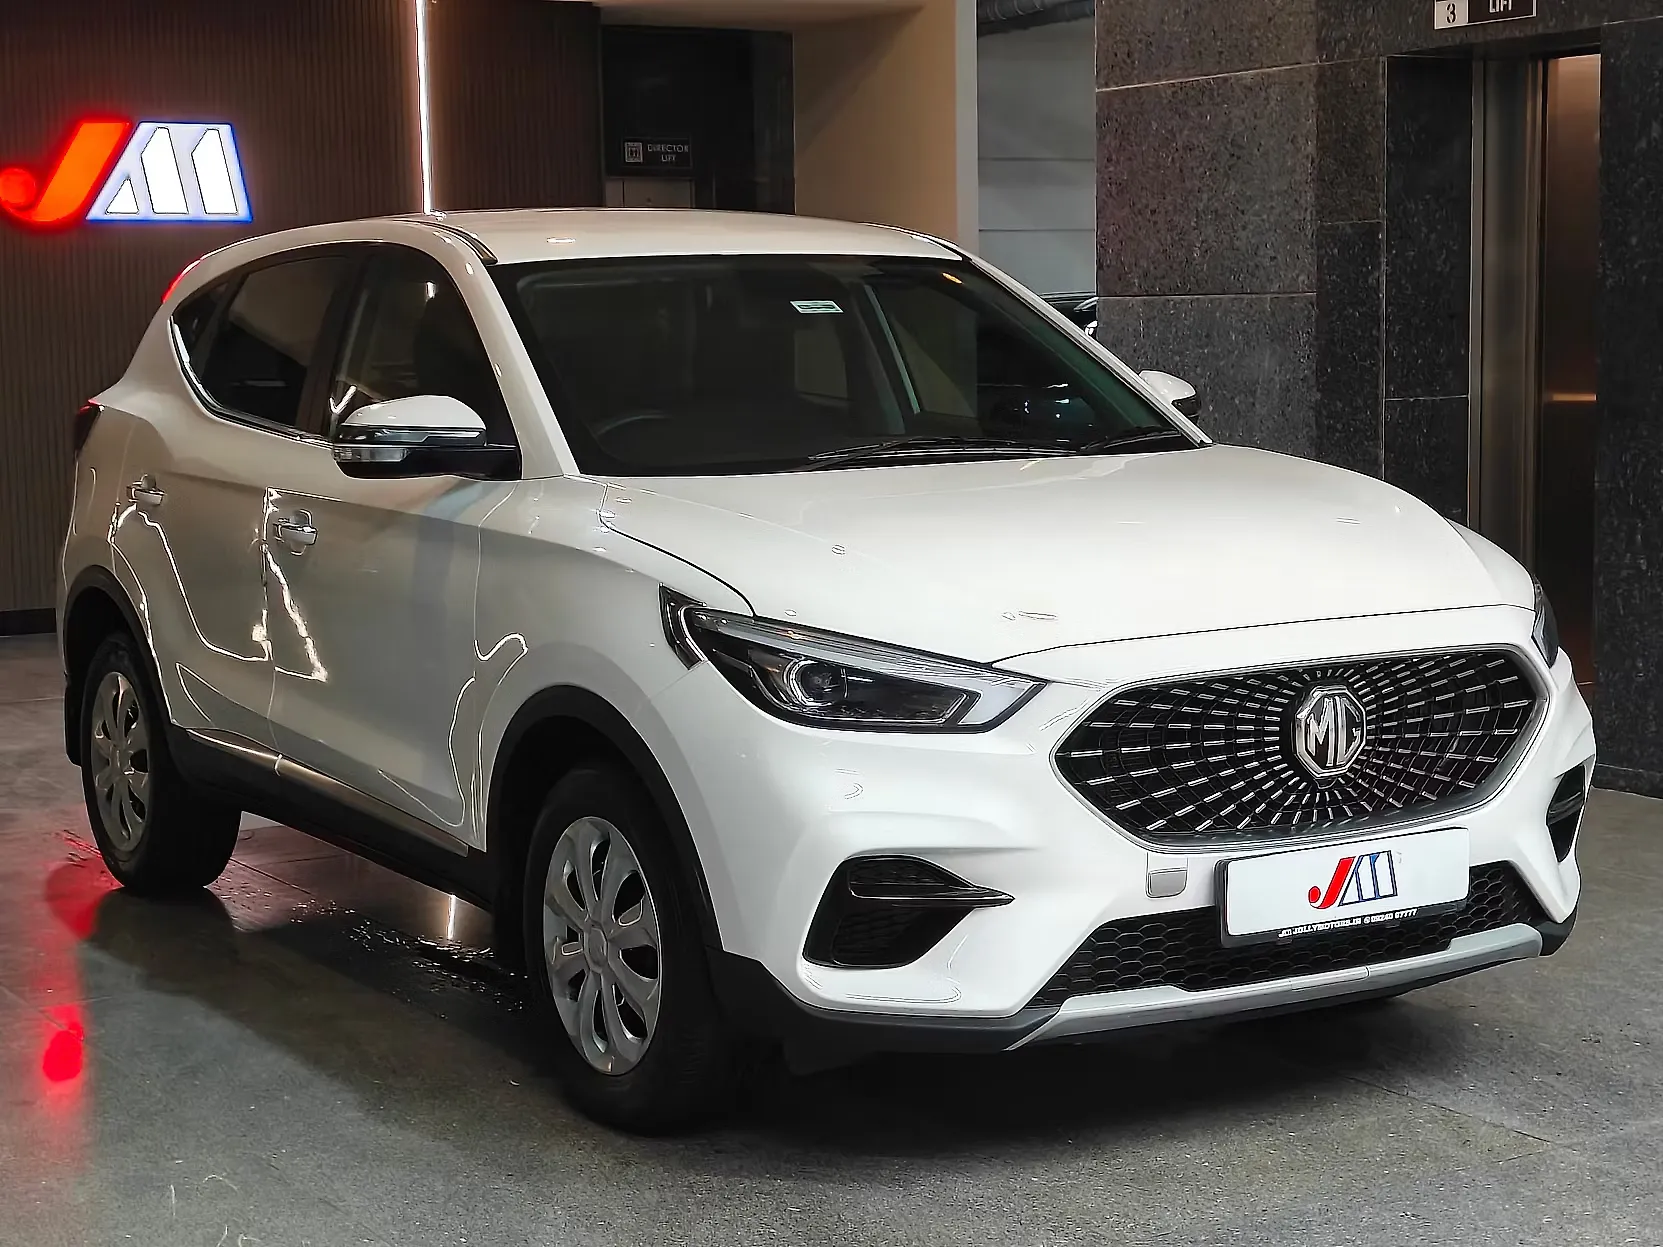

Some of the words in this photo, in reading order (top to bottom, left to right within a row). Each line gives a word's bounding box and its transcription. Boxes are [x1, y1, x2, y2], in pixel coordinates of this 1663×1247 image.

[1446, 3, 1456, 23] 3
[647, 144, 689, 152] DIRECTOR
[1307, 696, 1361, 766] MG
